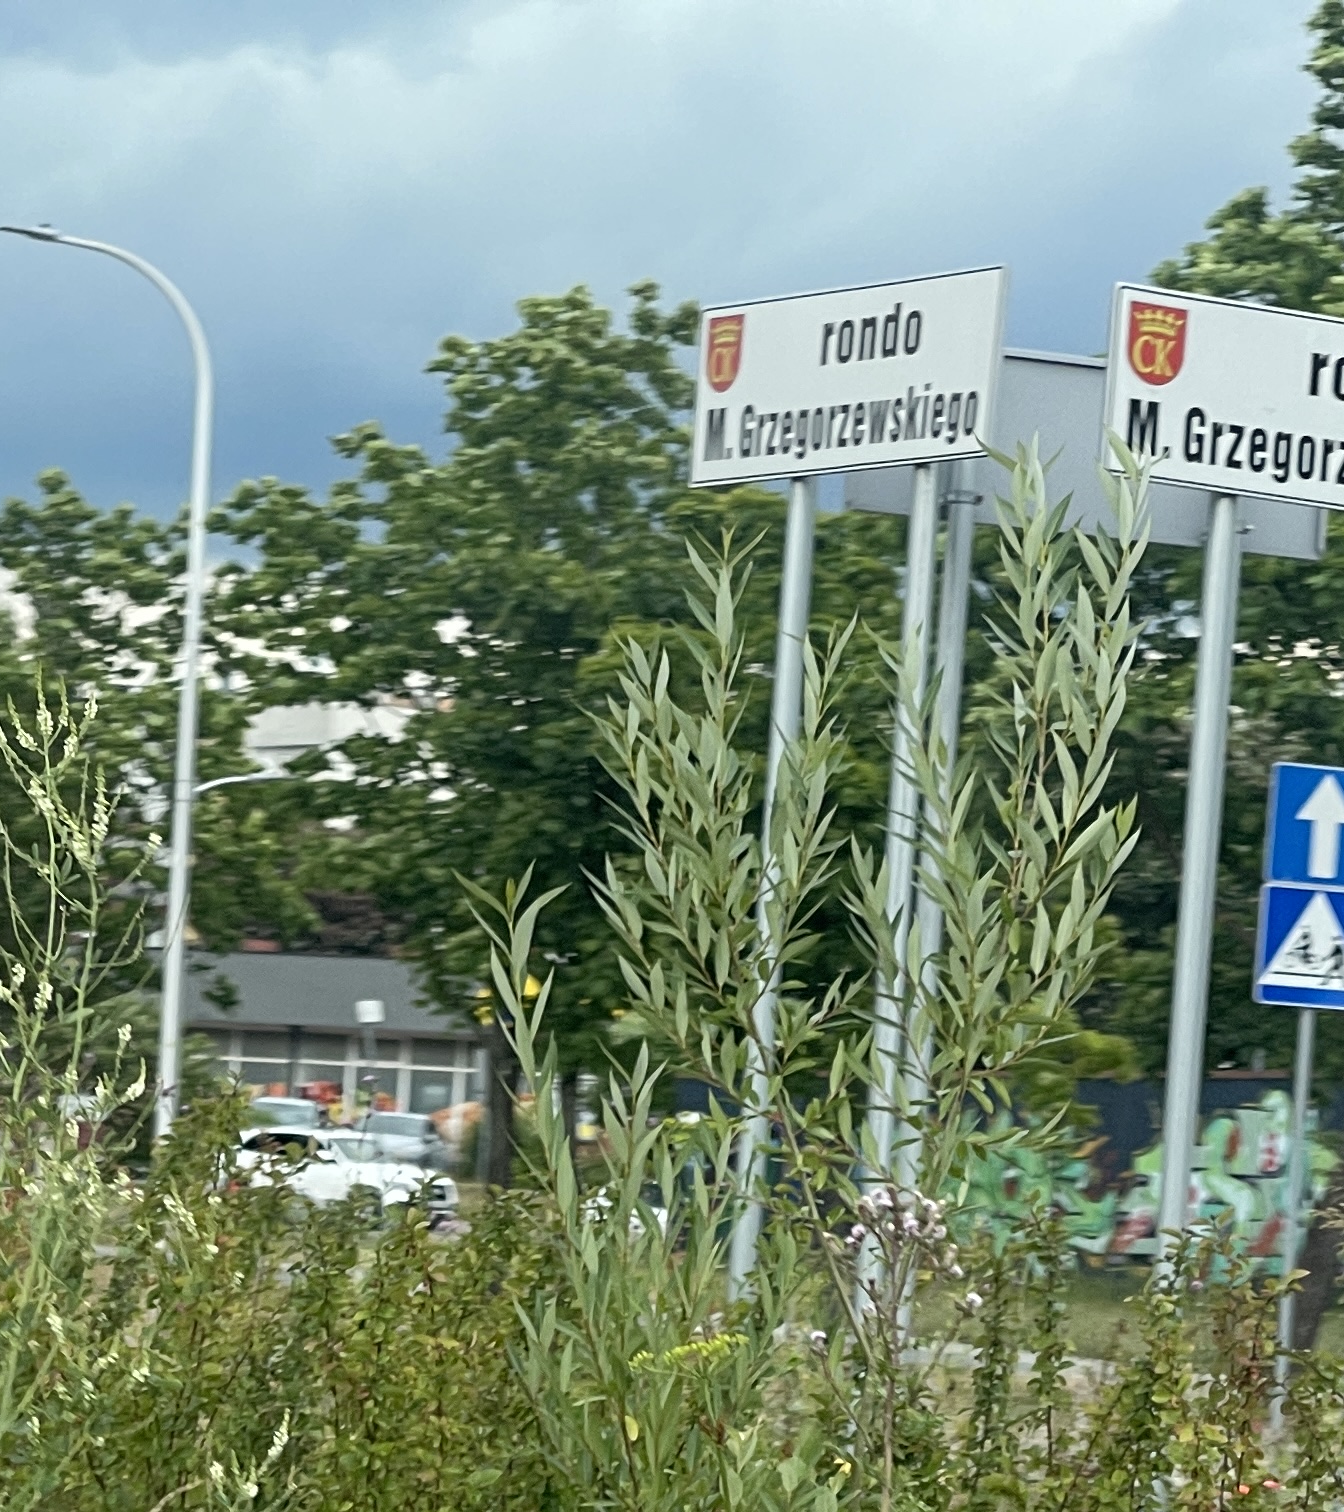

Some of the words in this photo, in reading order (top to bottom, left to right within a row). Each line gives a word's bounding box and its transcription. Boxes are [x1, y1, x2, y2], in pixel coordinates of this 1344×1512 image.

[819, 302, 924, 367] rondo
[703, 407, 733, 462] M.
[739, 383, 979, 460] Grzegorzewskiego
[1127, 397, 1170, 459] M.
